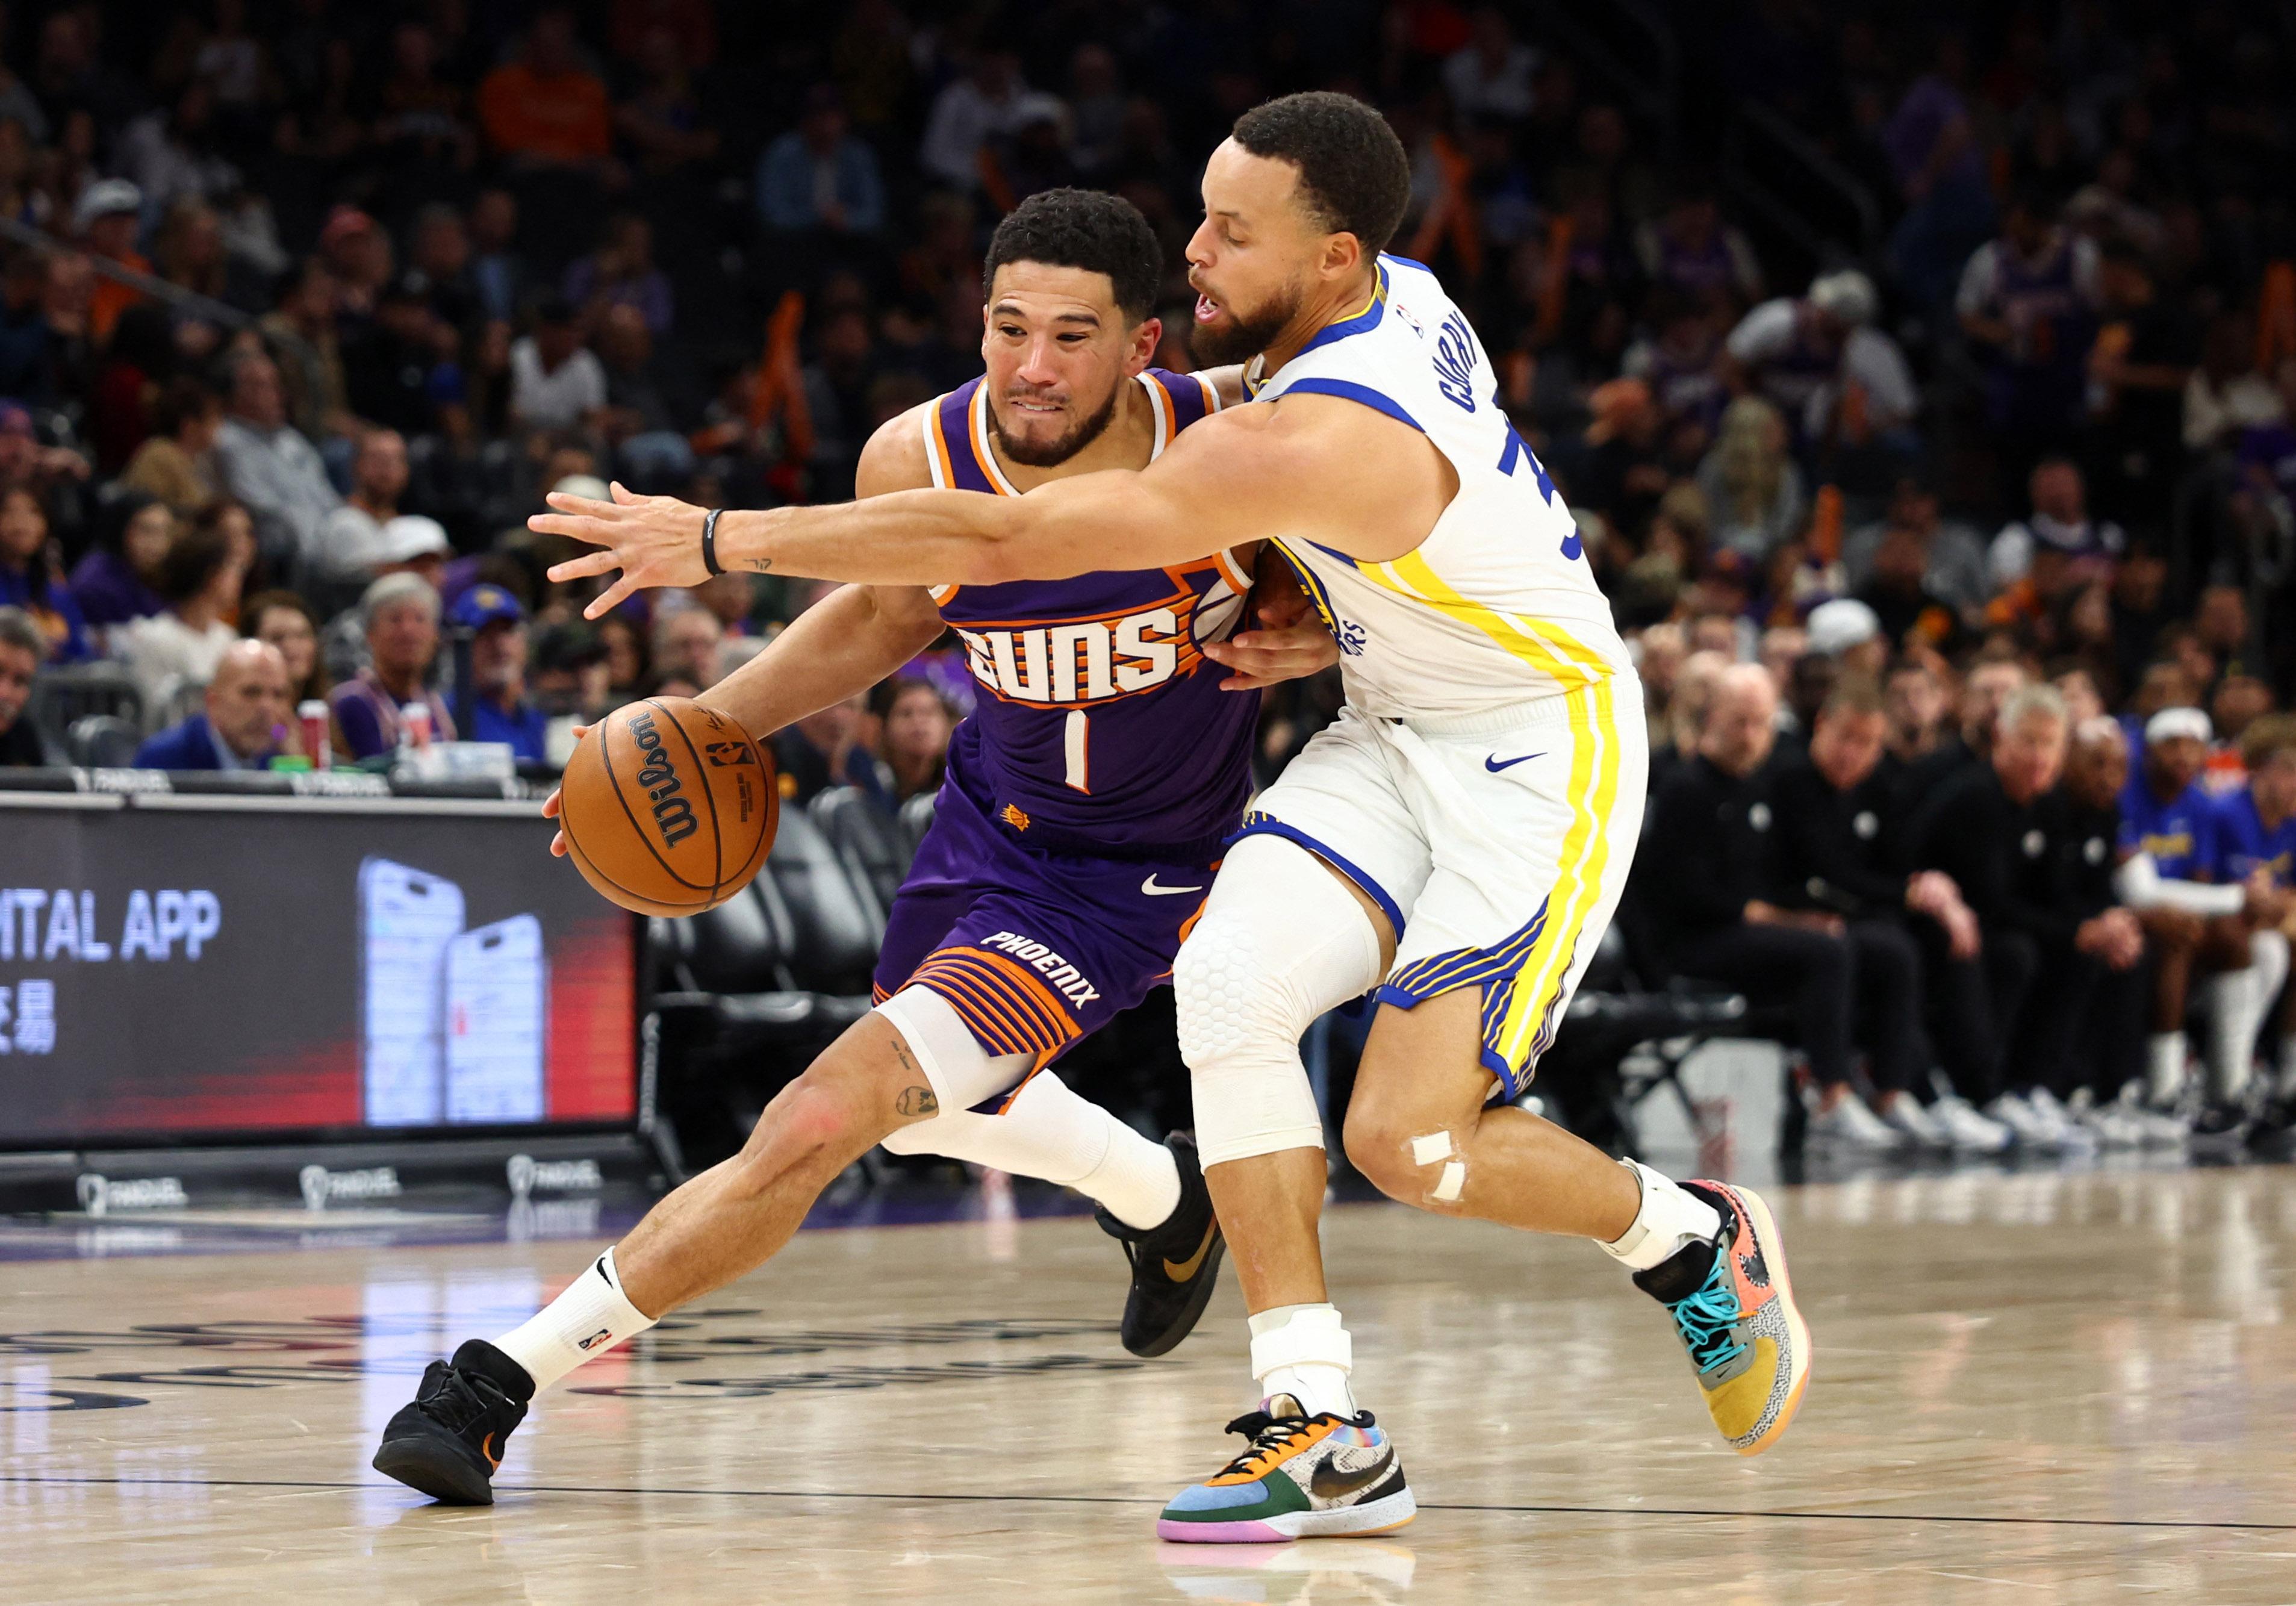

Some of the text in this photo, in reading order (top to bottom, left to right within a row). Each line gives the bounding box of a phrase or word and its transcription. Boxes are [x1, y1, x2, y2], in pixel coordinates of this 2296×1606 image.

[1432, 310, 1477, 413] CURRY
[627, 711, 699, 850] Wilson
[1065, 709, 1090, 795] 1
[120, 889, 222, 962] APP
[980, 930, 1101, 1010] PHOENIX
